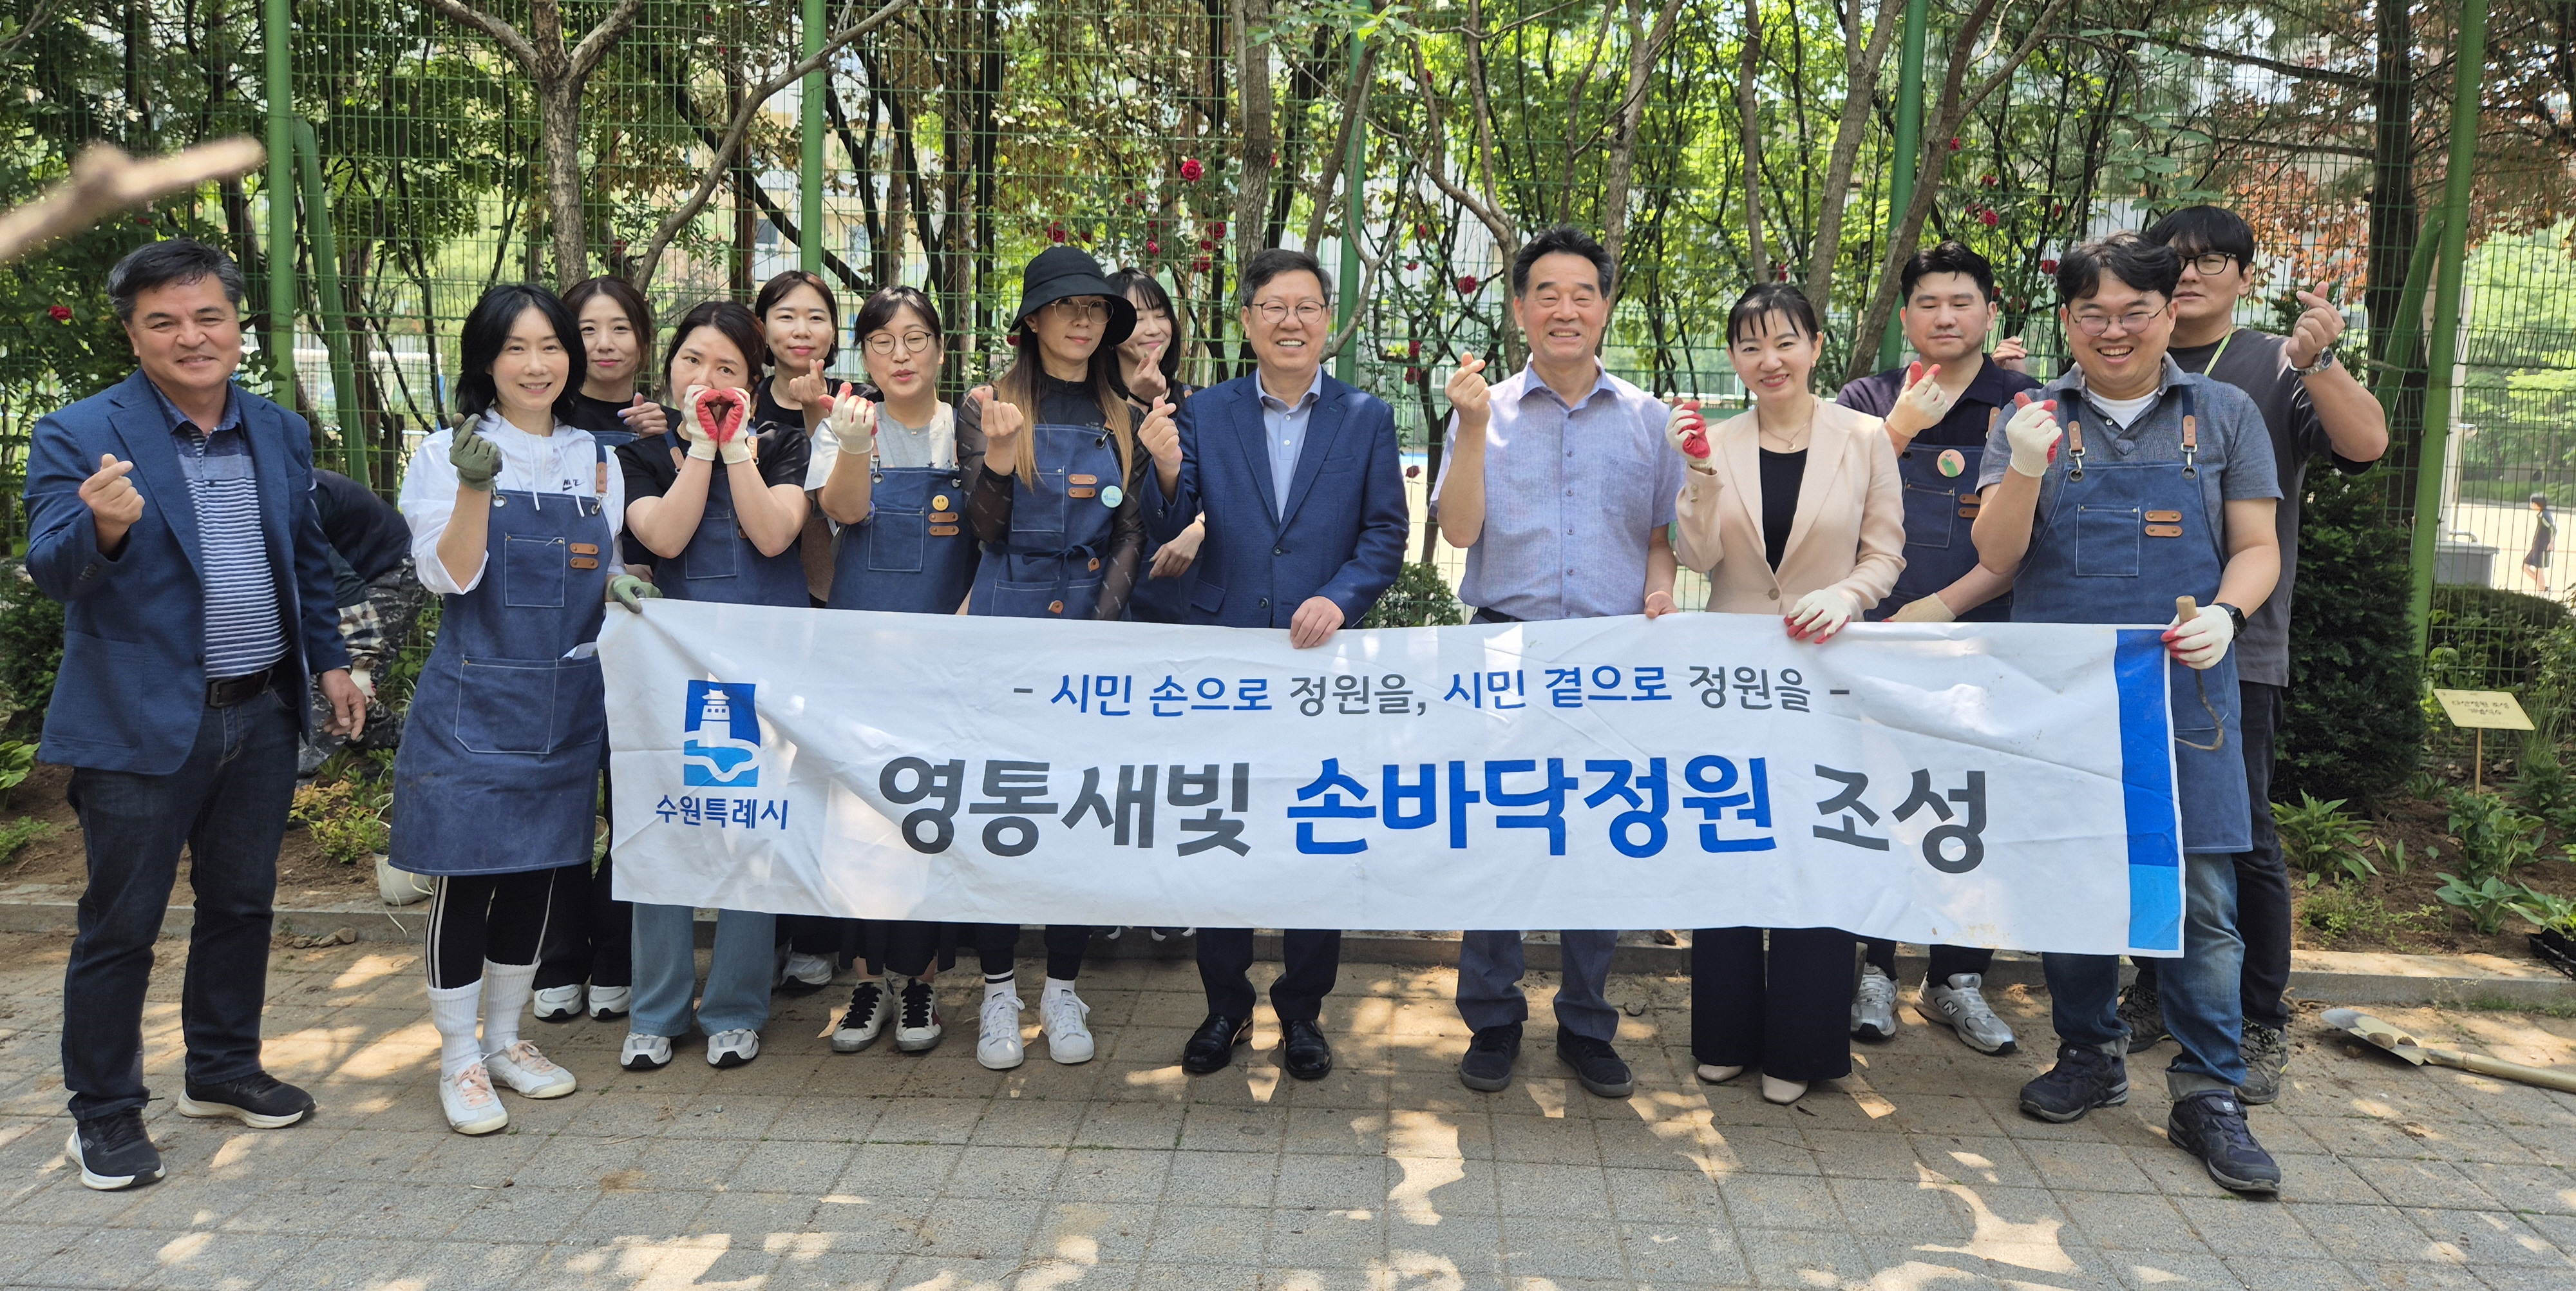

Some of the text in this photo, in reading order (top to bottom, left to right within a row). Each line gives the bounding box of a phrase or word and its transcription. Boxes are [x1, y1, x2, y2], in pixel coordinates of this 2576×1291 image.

[1051, 674, 1132, 716] 시민
[1150, 675, 1272, 716] 손으로
[1290, 674, 1426, 716] 정원을,
[1444, 670, 1526, 709] 시민
[1545, 665, 1672, 707] 곁으로
[1690, 666, 1810, 712] 정원을
[656, 795, 788, 830] 수원특례시
[880, 755, 1986, 874] 영통새빛 손바닥정원 조성
